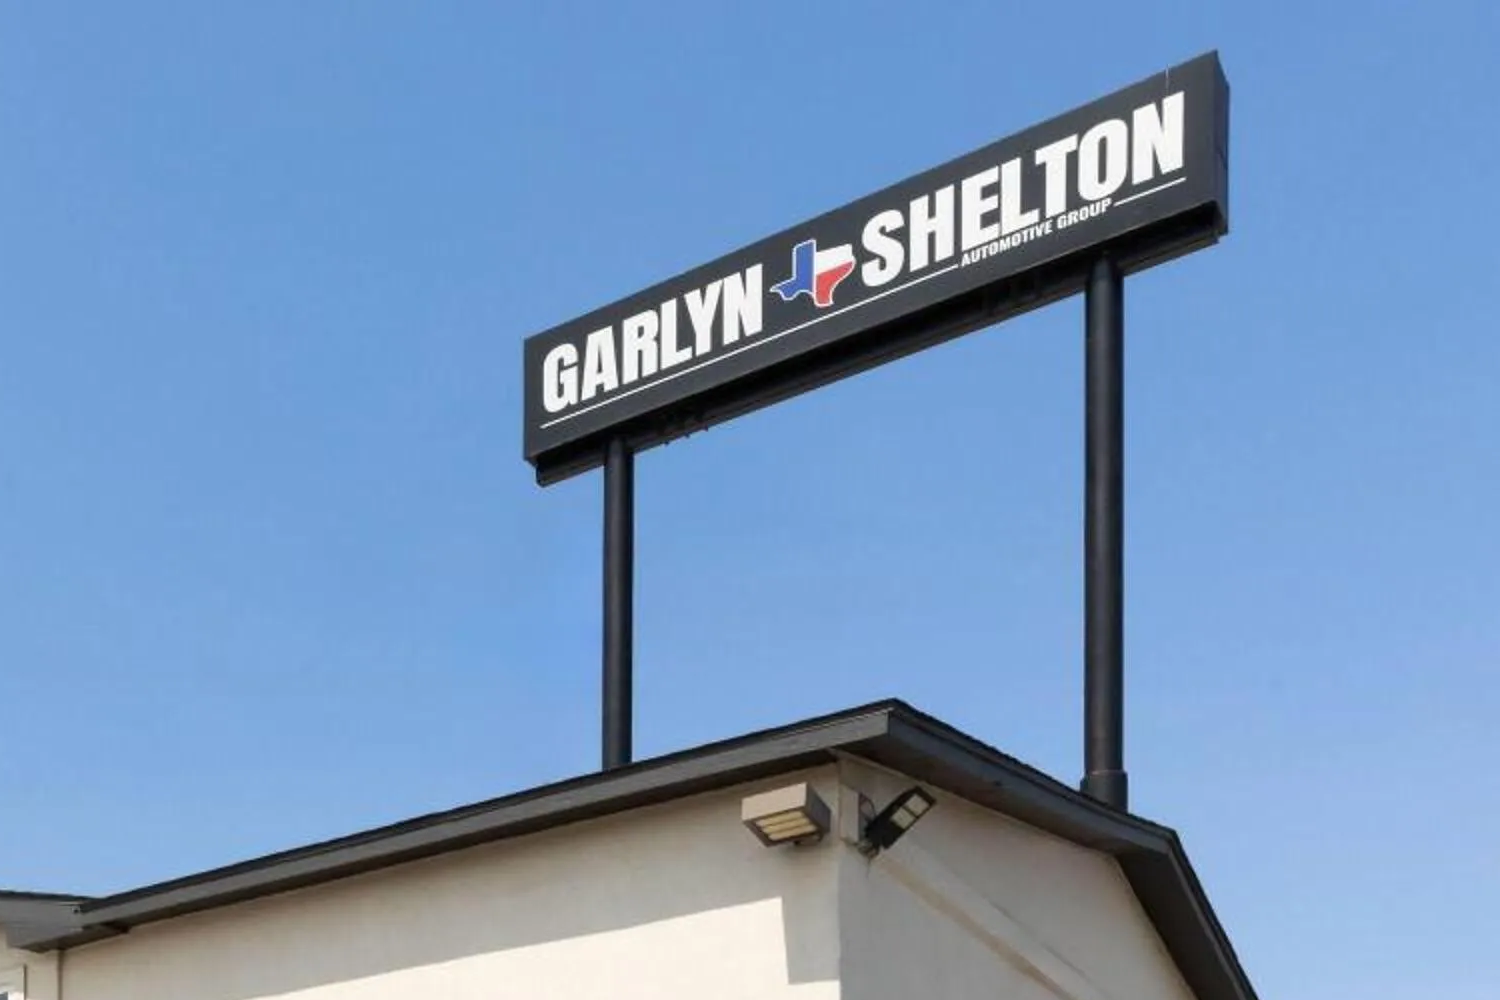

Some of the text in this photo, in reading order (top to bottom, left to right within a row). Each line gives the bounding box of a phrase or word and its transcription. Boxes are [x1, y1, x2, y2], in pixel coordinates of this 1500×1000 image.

[542, 91, 1185, 413] GARLYN SHELTON
[961, 198, 1112, 267] AUTOMOTIVE GROUP
